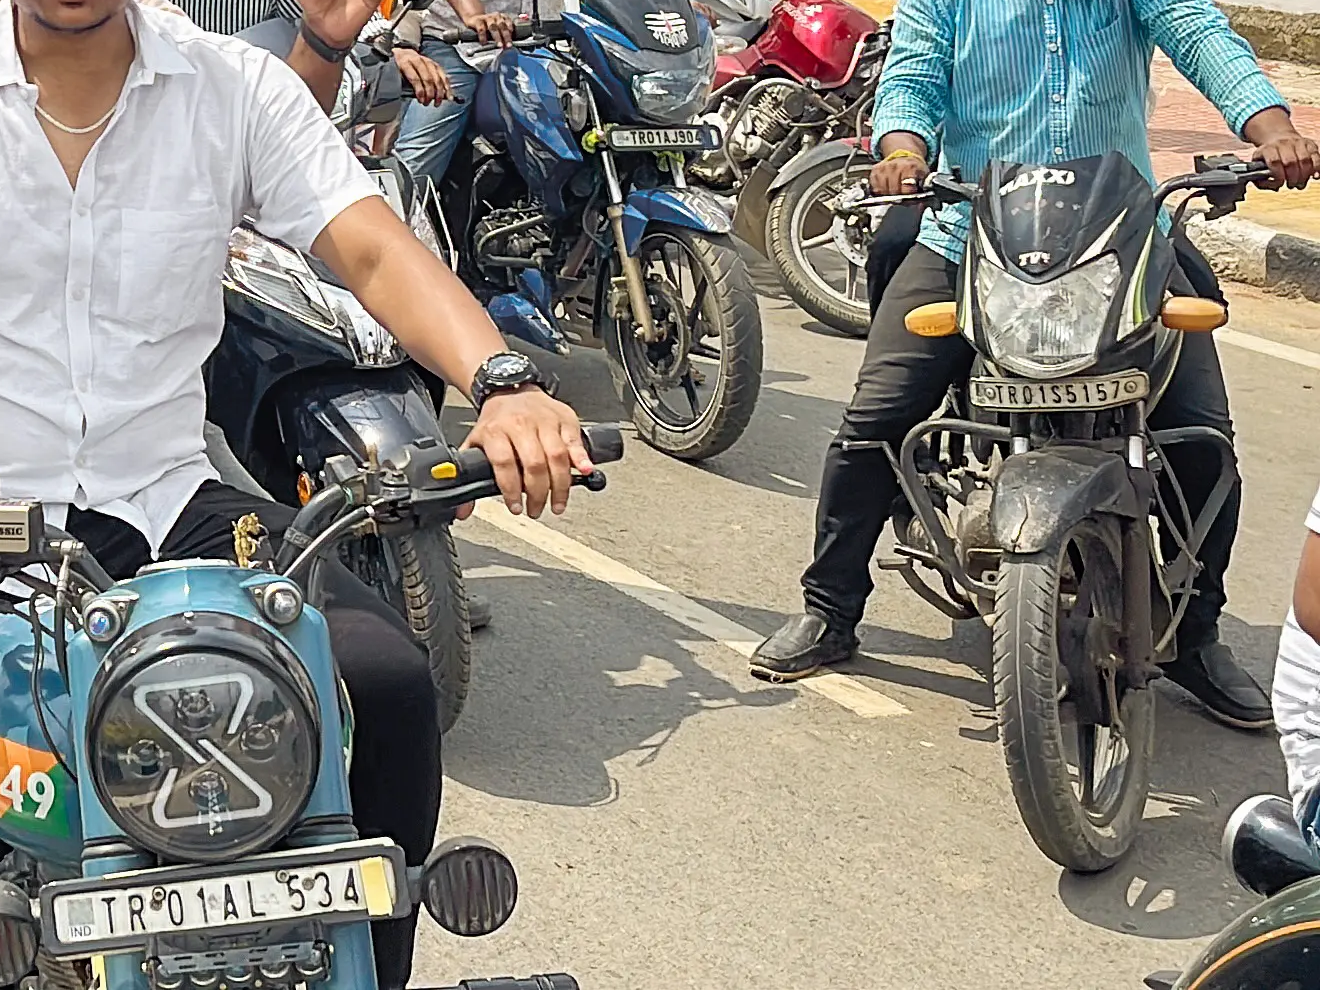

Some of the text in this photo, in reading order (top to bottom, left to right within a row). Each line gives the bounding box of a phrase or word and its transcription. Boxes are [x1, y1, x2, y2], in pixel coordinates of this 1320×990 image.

[995, 380, 1120, 404] TR01S5157
[0, 764, 55, 820] 49
[69, 925, 93, 938] IND
